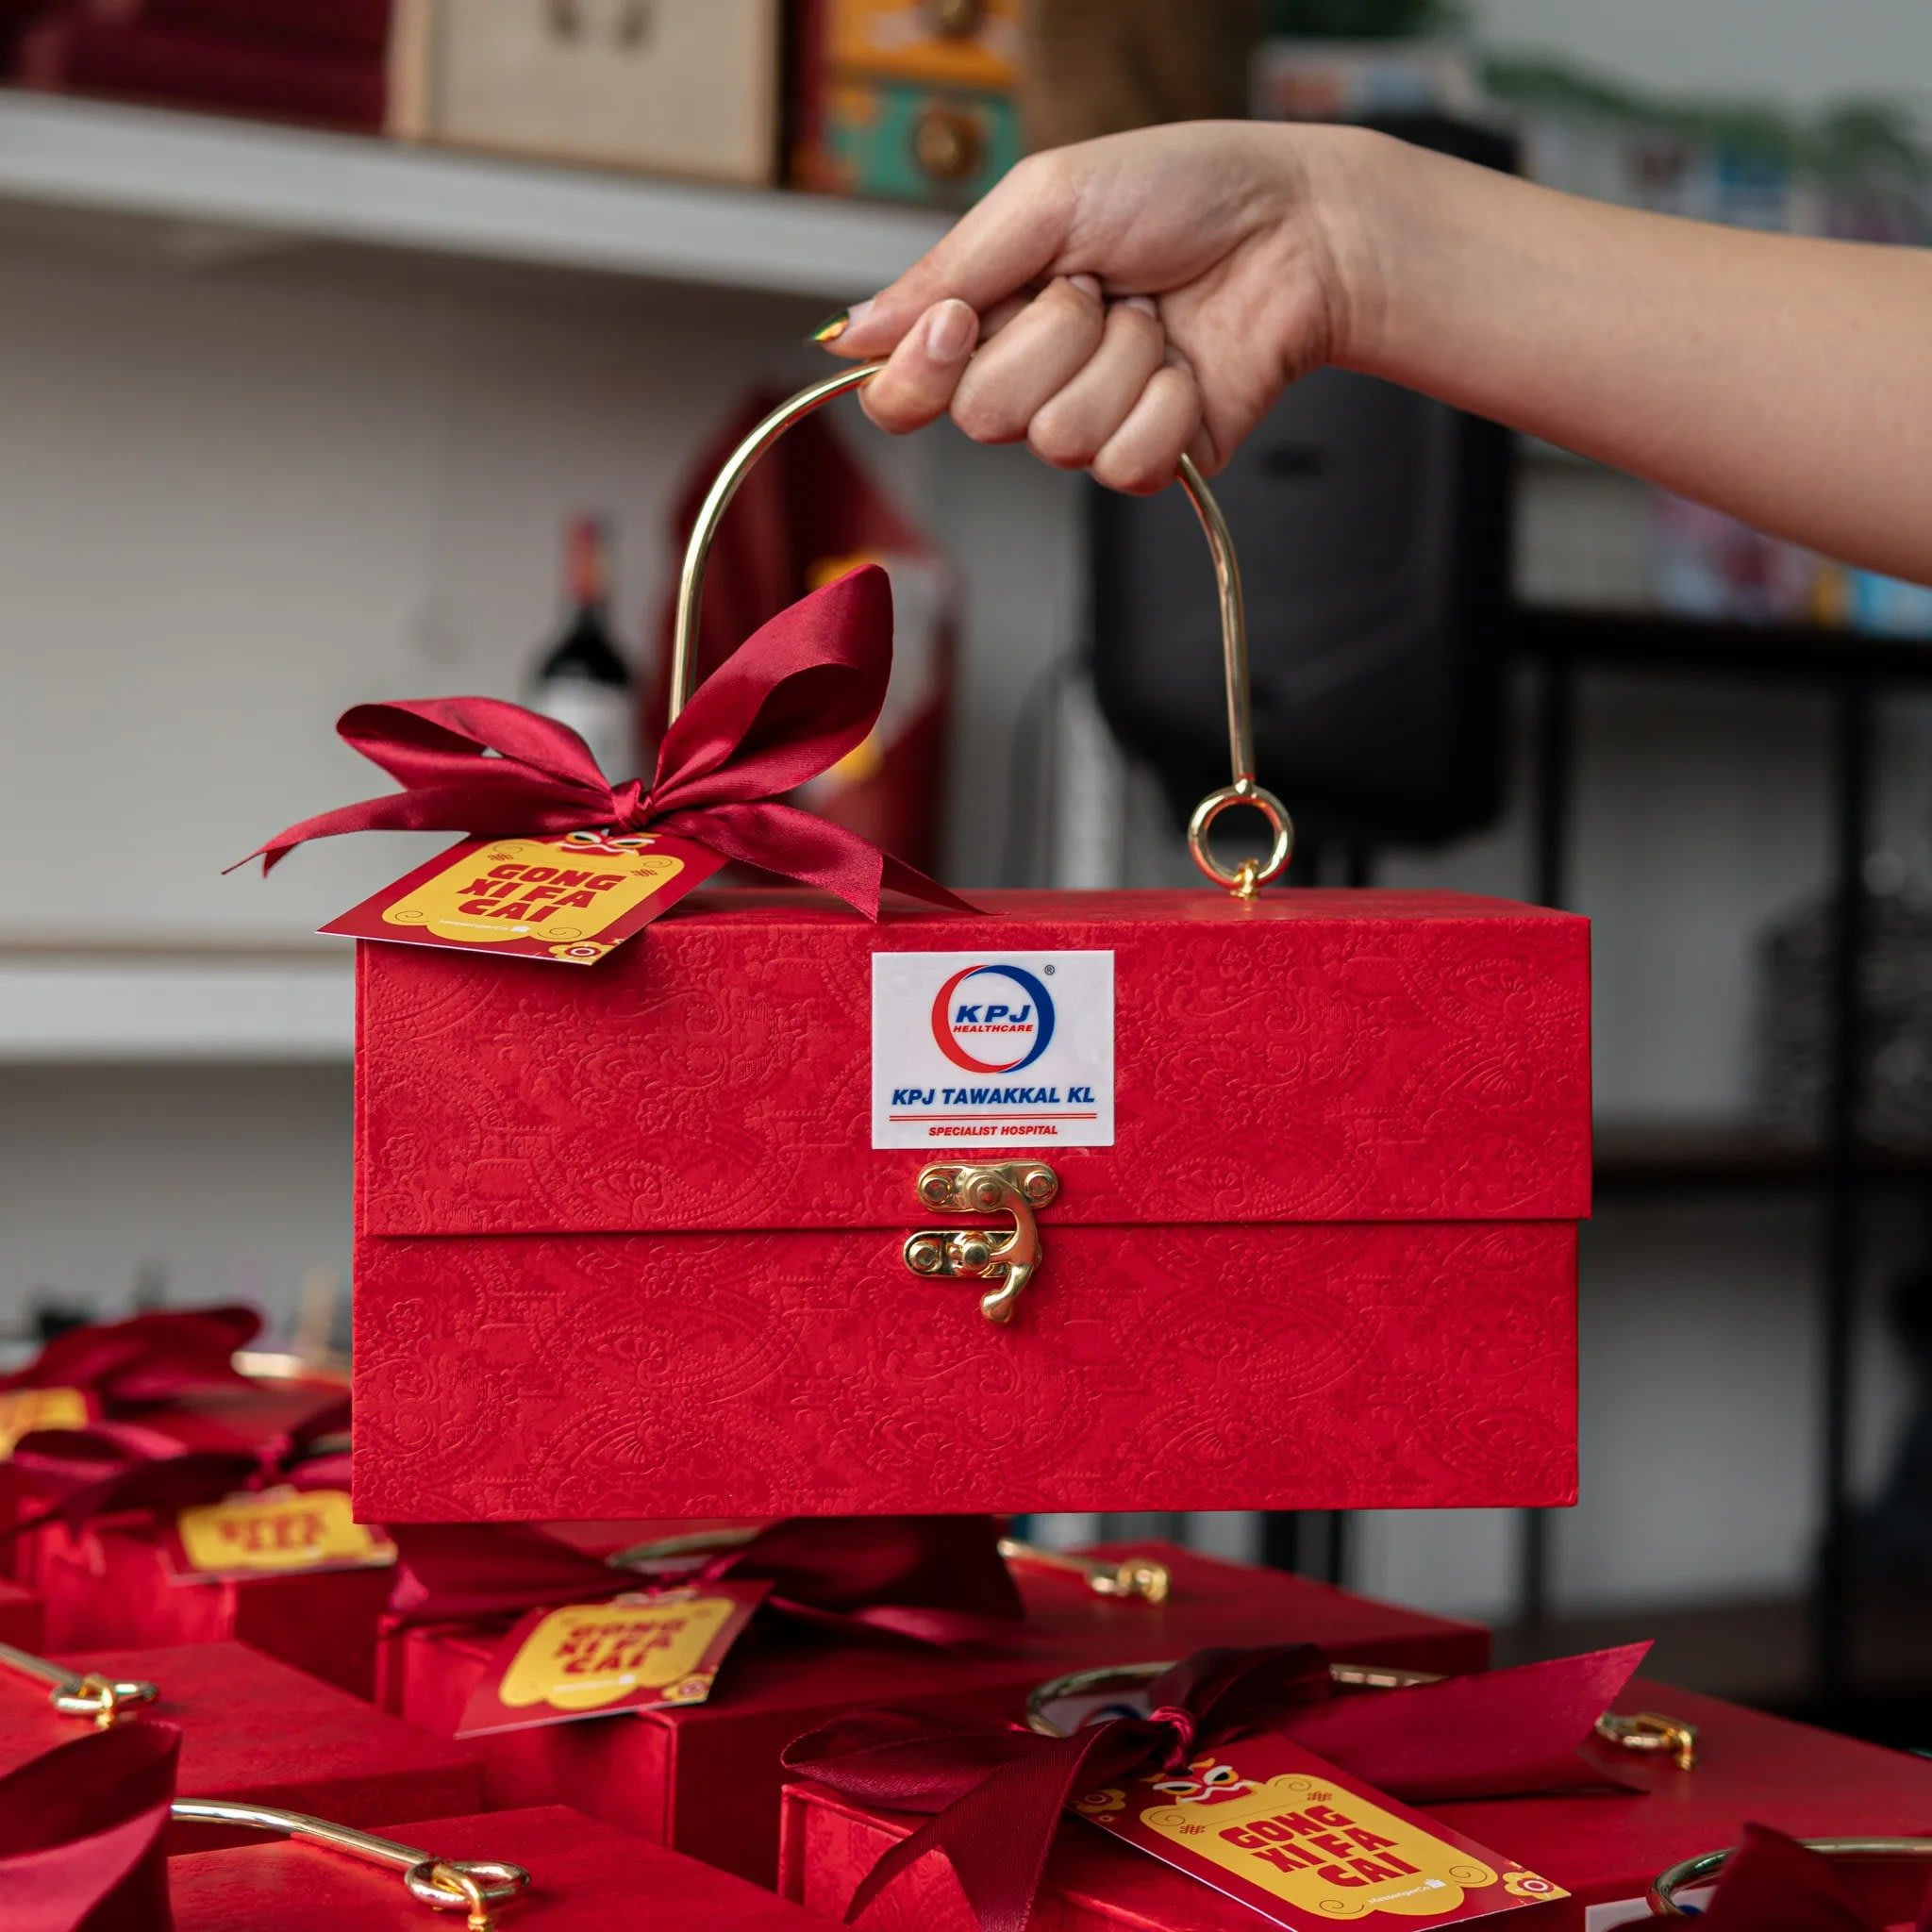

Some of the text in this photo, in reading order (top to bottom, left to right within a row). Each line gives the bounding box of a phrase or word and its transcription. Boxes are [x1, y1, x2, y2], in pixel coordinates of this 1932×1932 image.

[487, 863, 627, 891] GONG
[456, 877, 597, 908] XI FA
[458, 898, 561, 923] CAI
[956, 1005, 1031, 1024] KPJ
[953, 1024, 1034, 1033] HEALTHCARE
[891, 1087, 1095, 1106] KPJ TAWAKKAL KL
[928, 1124, 1058, 1137] SPECIALIST HOSPITAL
[1218, 1805, 1357, 1849] GONG
[1250, 1826, 1400, 1874] XI FA
[1317, 1851, 1423, 1888] CAI
